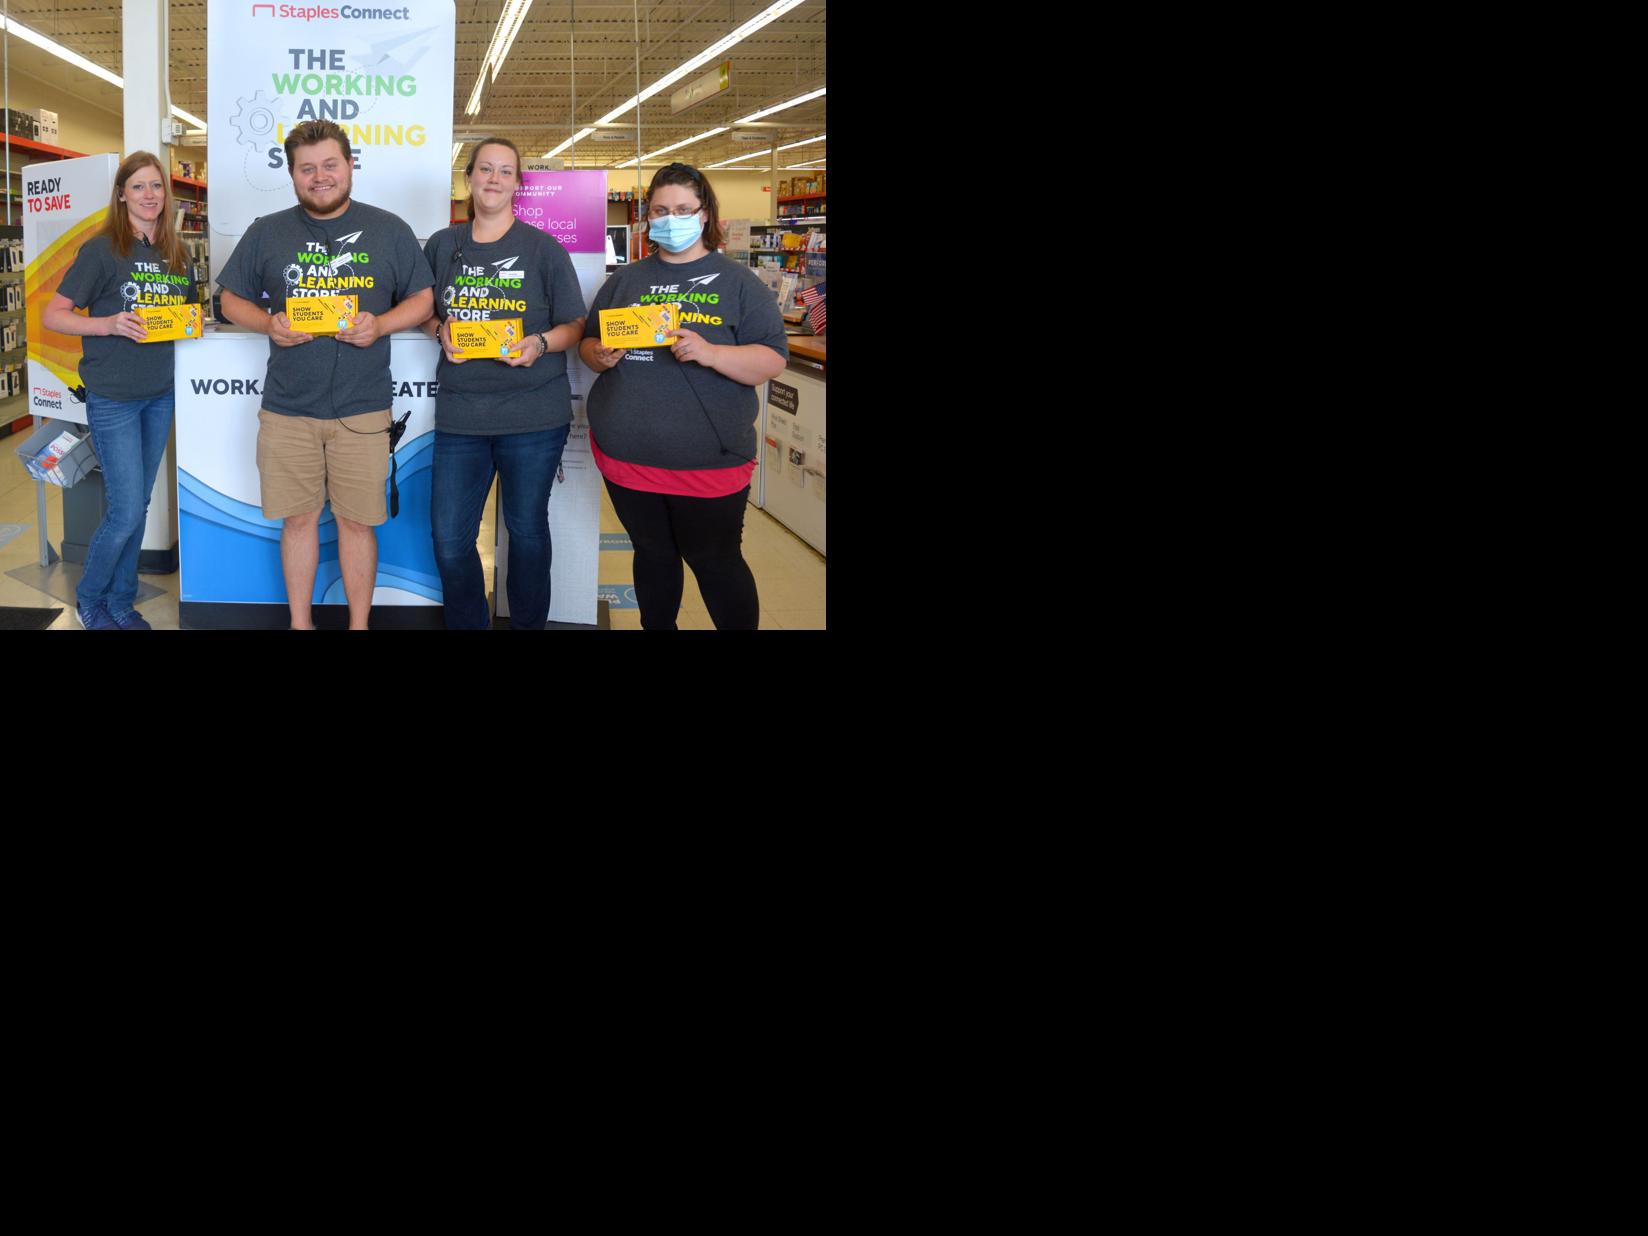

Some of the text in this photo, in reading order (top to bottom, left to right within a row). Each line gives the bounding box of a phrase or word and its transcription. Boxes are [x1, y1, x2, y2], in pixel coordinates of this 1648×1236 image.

[288, 48, 346, 71] THE
[271, 72, 417, 97] WORKING
[296, 98, 360, 120] AND
[27, 177, 62, 196] READY
[27, 194, 71, 213] TO SAVE
[512, 204, 544, 219] Shop
[548, 218, 577, 230] local
[134, 262, 161, 273] THE
[462, 264, 486, 277] THE
[130, 272, 190, 287] WORKING
[298, 276, 375, 290] LEARNING
[455, 275, 522, 289] WORKING
[144, 282, 170, 295] AND
[458, 286, 490, 298] AND
[650, 284, 680, 294] THE
[136, 290, 188, 306] LEARNIN
[450, 295, 527, 312] LEARNING
[640, 292, 720, 305] WORKING
[446, 308, 491, 322] STORE
[679, 311, 723, 325] NING
[146, 319, 174, 327] STUDENTS
[625, 353, 655, 362] Connect
[42, 388, 62, 399] Staples
[190, 378, 439, 398] WORK. EATE
[33, 396, 63, 410] Connect
